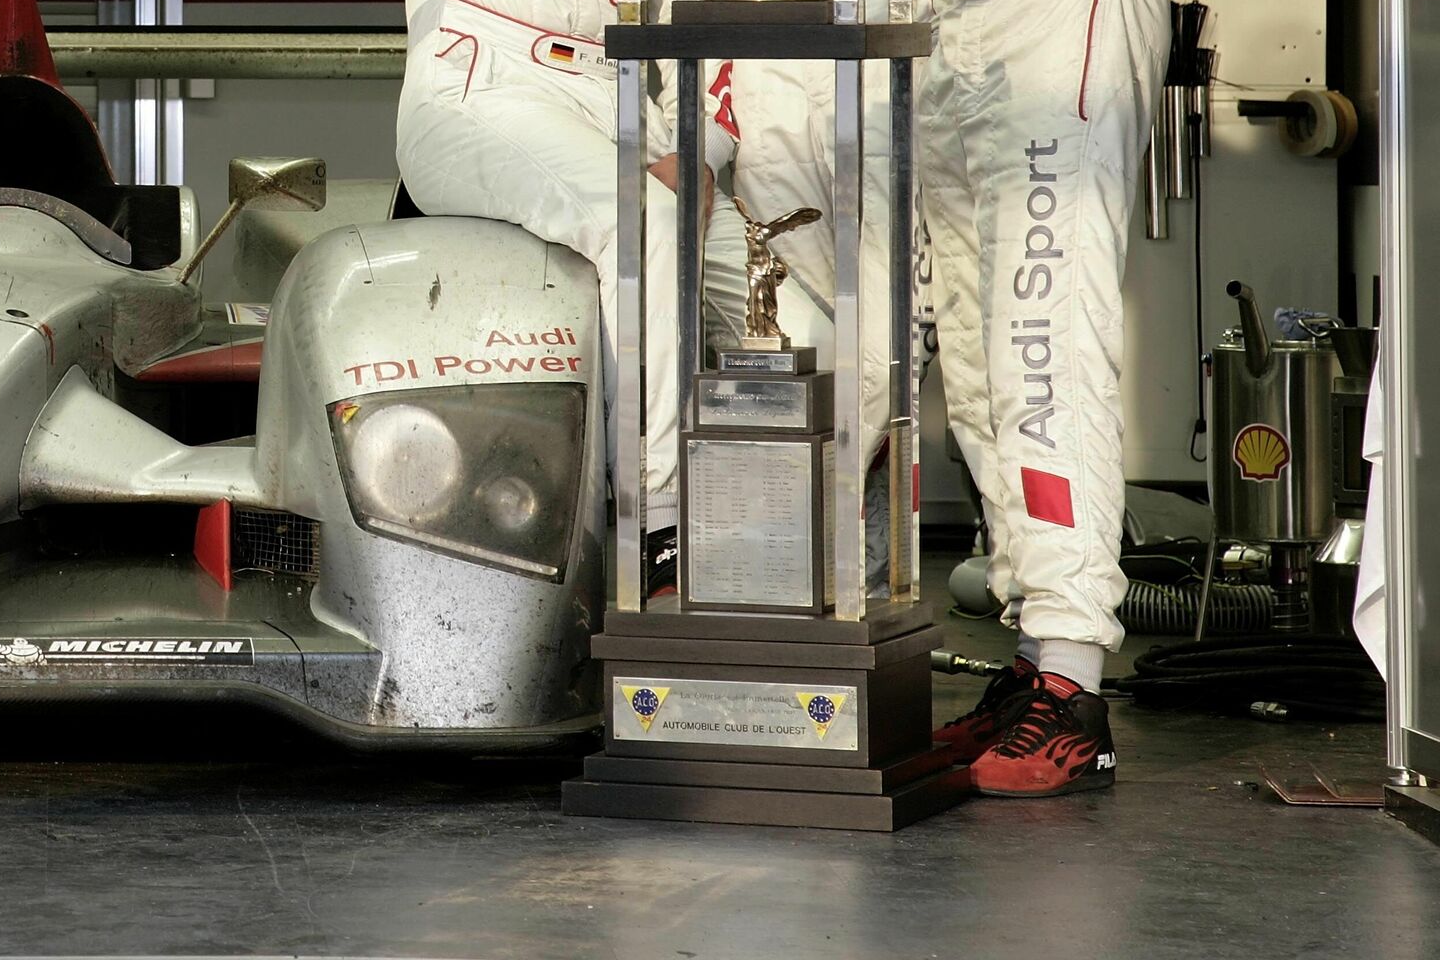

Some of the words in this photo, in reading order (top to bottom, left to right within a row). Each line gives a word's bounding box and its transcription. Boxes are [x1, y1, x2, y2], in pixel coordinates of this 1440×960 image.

[579, 52, 591, 63] F.
[1013, 138, 1064, 301] Sport
[484, 327, 577, 348] Audi
[343, 358, 419, 387] TDI
[433, 353, 583, 377] Power
[1011, 319, 1057, 449] Audi
[48, 640, 244, 654] MICHELIN
[662, 720, 720, 731] AUTOMOBILE
[724, 723, 749, 733] CLUB
[752, 724, 765, 733] DE
